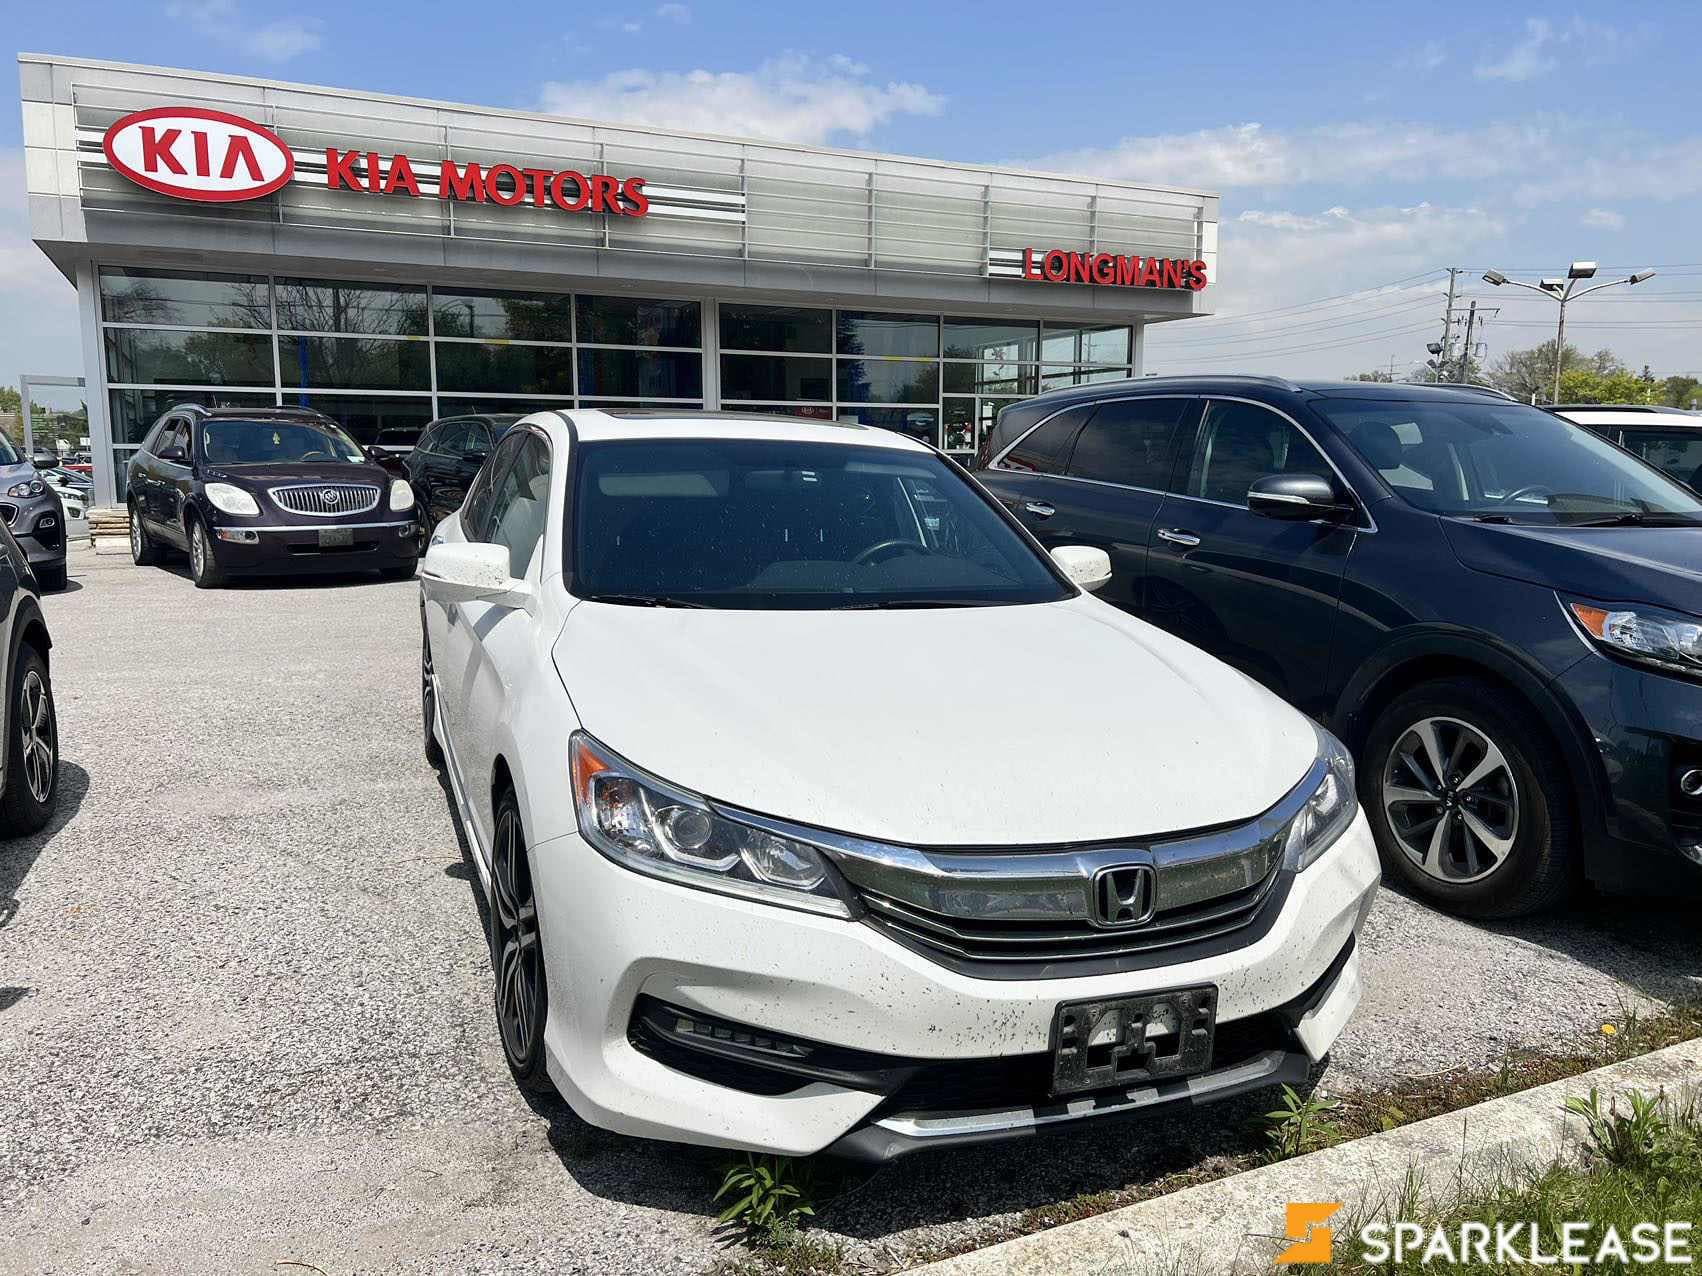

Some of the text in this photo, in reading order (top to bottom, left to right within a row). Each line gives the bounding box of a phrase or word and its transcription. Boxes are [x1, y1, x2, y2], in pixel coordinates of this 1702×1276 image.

[139, 125, 266, 182] KIA
[326, 147, 649, 217] KIA MOTORS
[1023, 247, 1208, 292] LONGMAN'S
